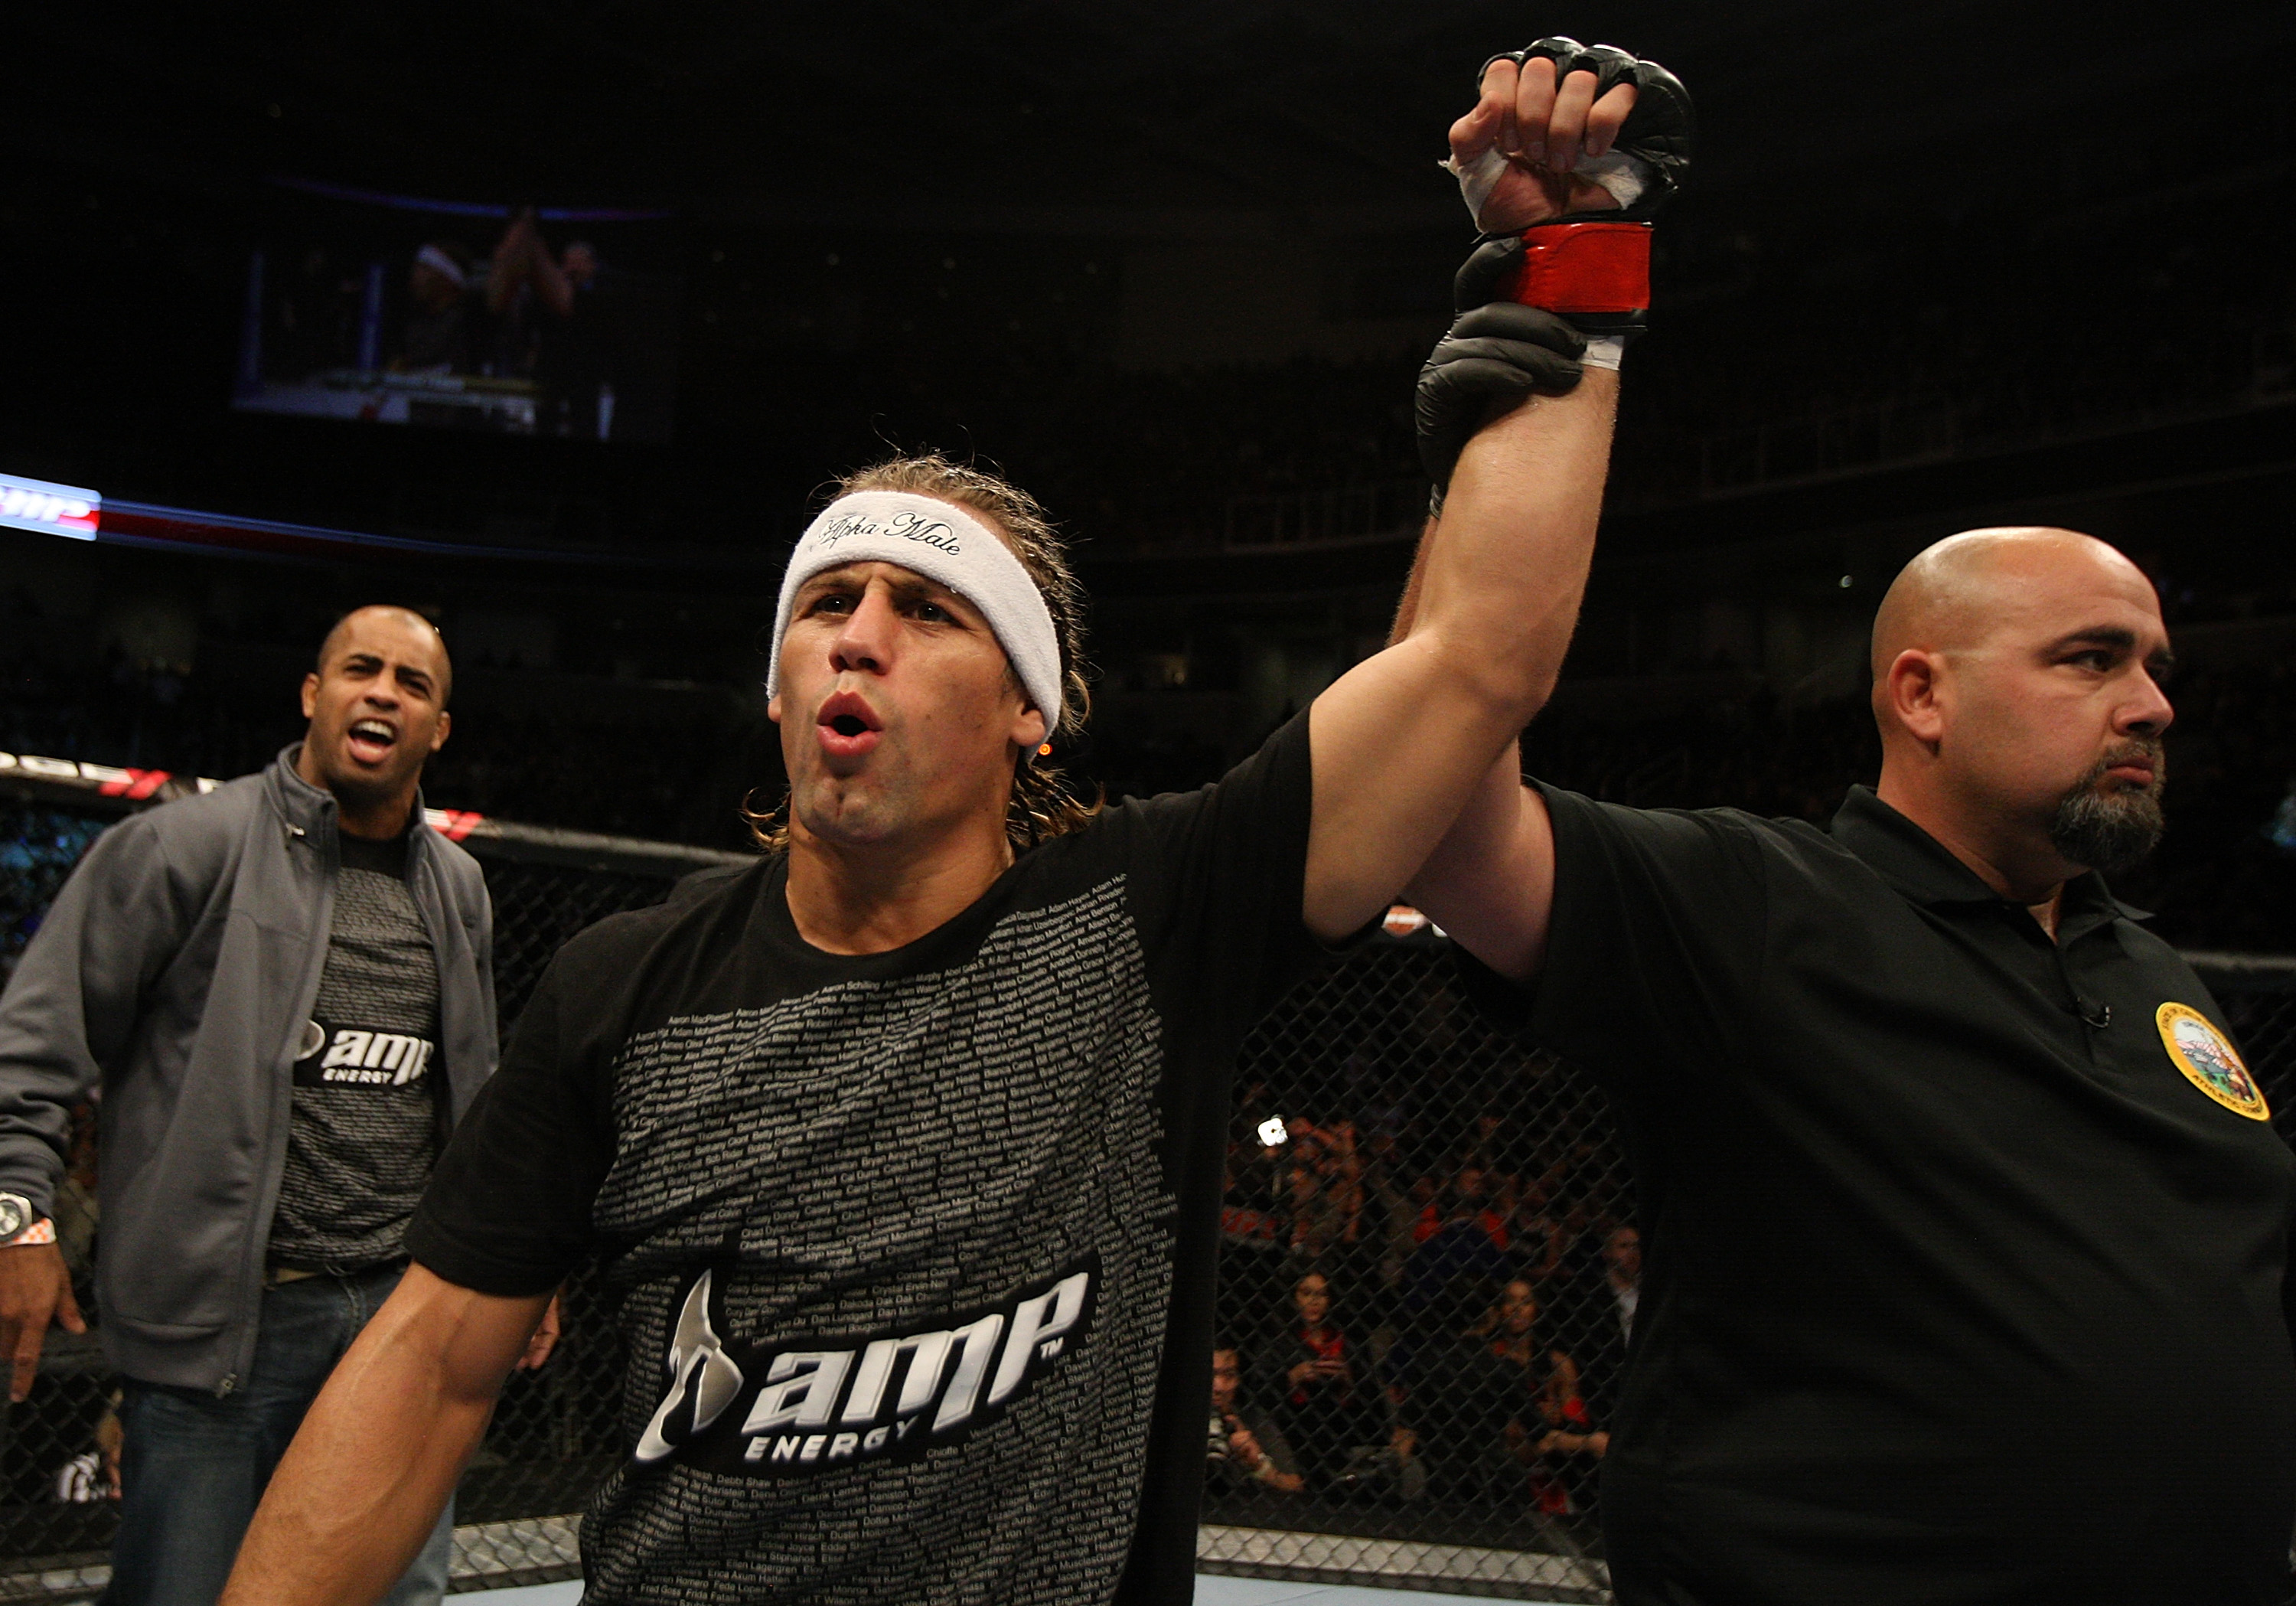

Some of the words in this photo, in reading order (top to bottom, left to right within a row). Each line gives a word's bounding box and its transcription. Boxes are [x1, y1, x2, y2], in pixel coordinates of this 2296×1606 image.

[884, 512, 961, 556] Male
[322, 1068, 393, 1085] ENERGY
[745, 1415, 918, 1462] ENERGY
